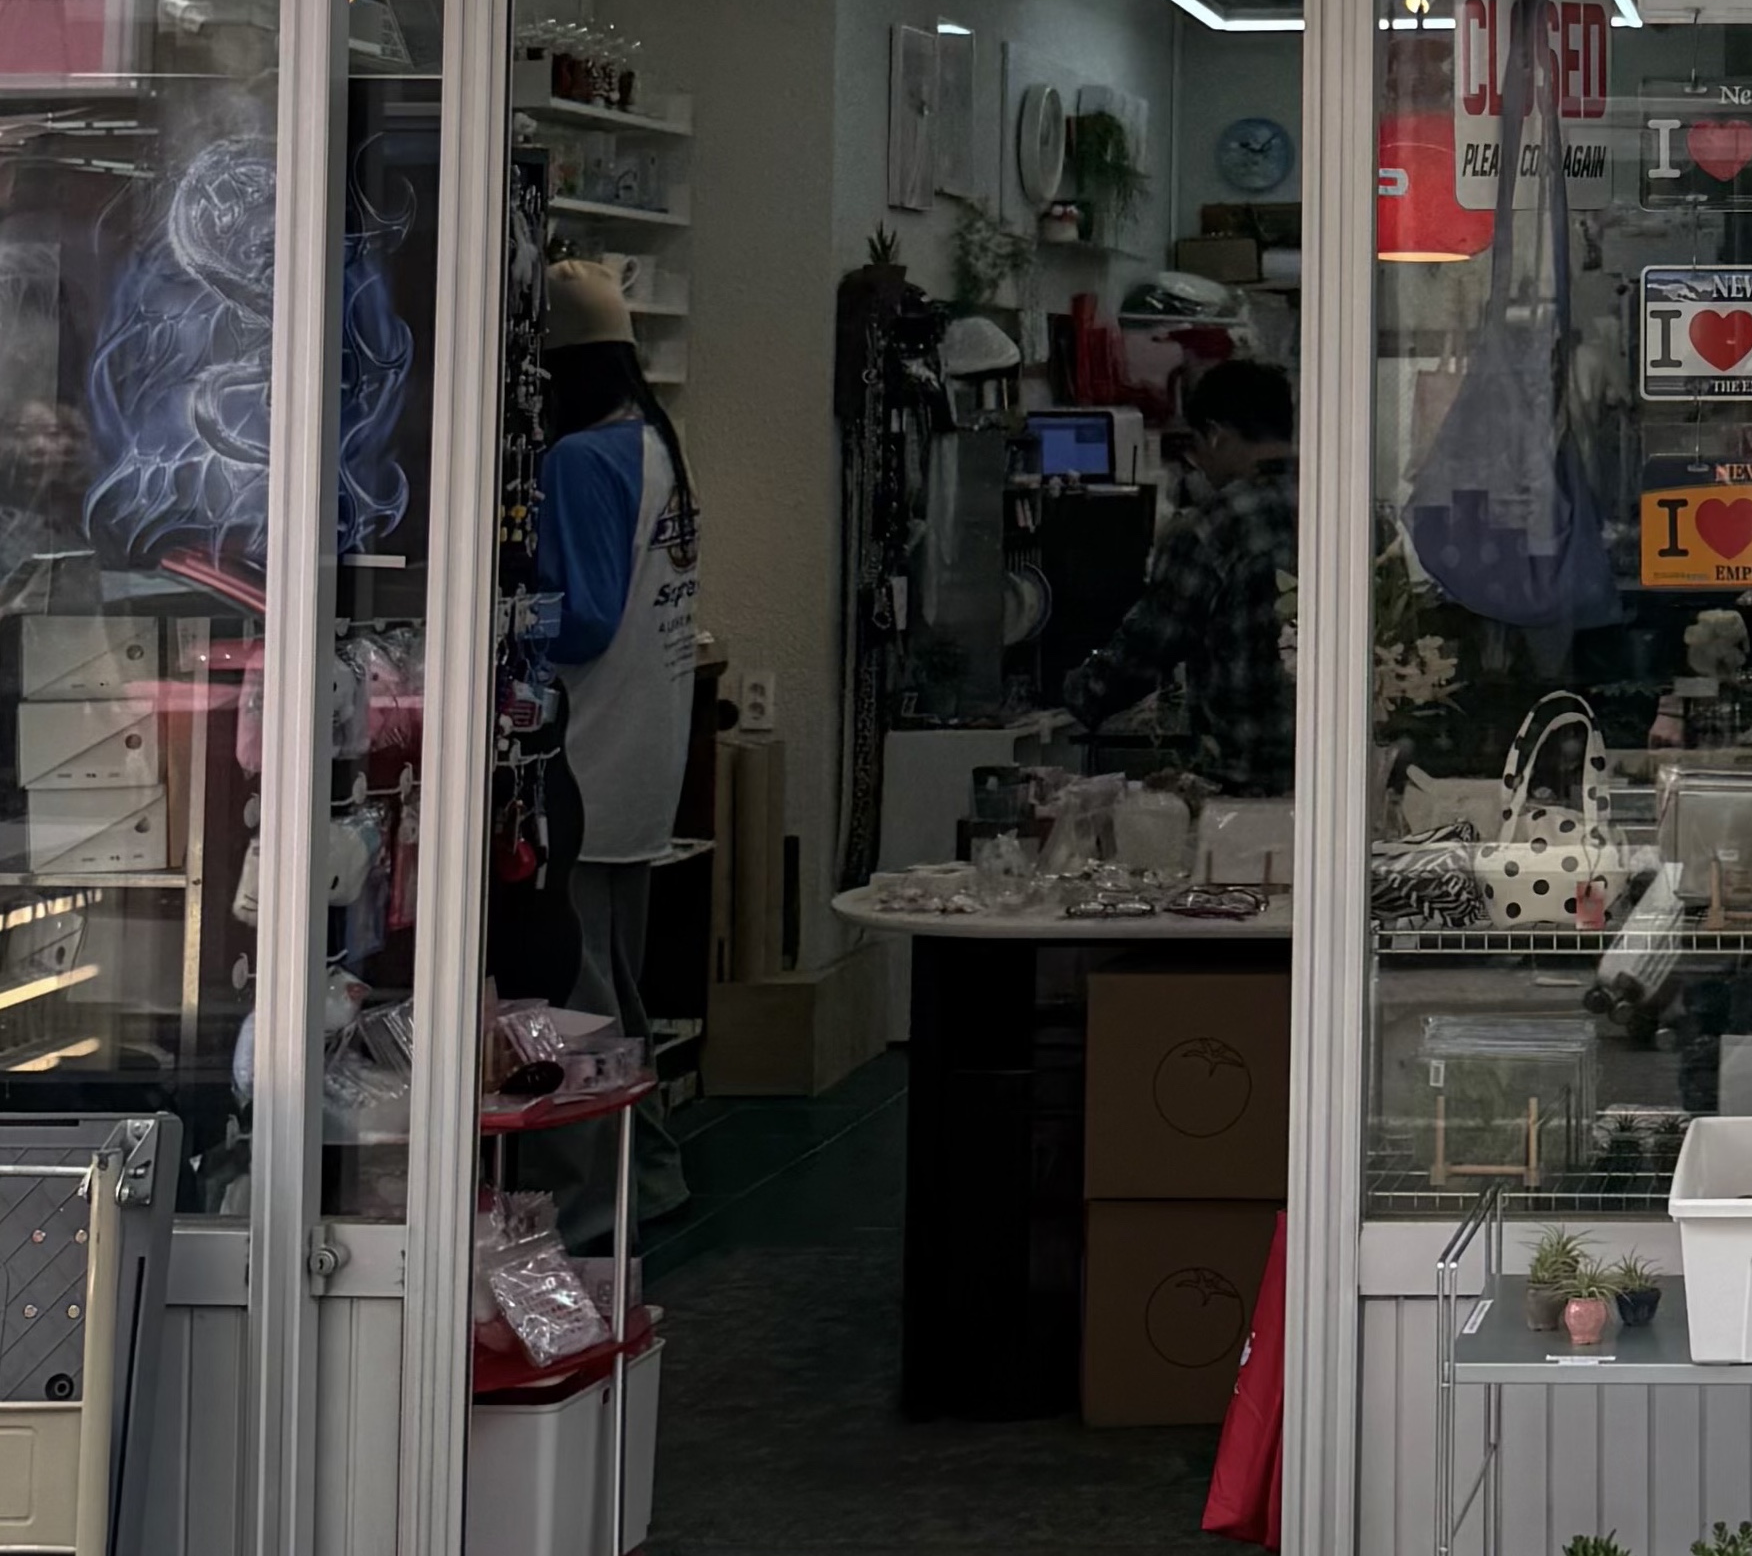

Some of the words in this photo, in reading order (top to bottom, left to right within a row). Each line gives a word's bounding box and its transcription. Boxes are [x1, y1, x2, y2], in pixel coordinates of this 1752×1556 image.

[1563, 146, 1607, 179] AGAIN
[1647, 119, 1681, 179] I
[1649, 309, 1683, 369] I
[1713, 379, 1740, 393] THE
[1656, 498, 1690, 558] I
